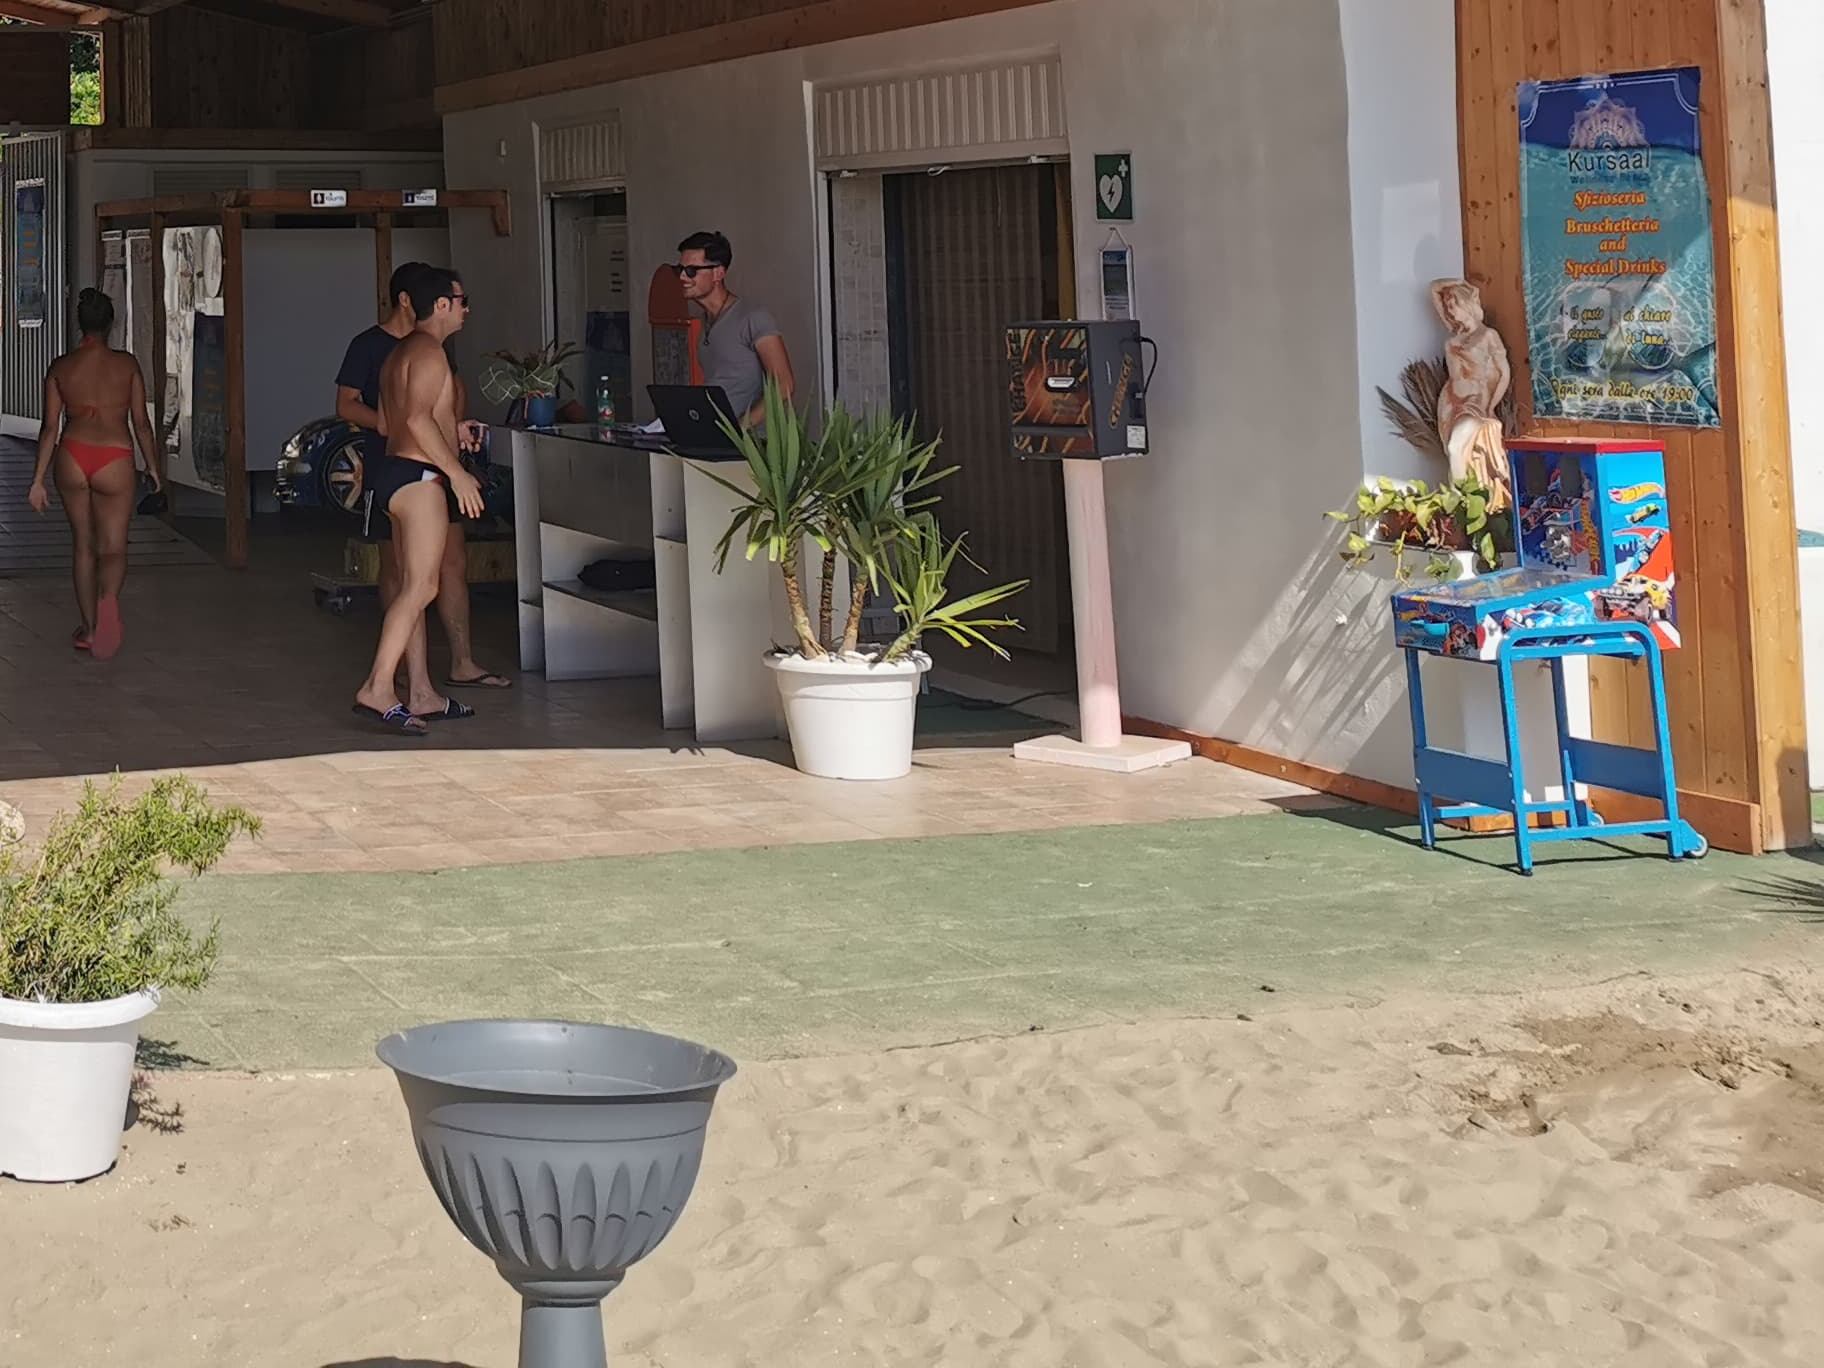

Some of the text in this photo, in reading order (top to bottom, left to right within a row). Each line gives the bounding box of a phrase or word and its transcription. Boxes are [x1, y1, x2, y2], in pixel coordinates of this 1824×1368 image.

[1568, 147, 1650, 172] Kursaal
[1574, 190, 1646, 211] Sfizioseria
[1565, 217, 1660, 235] Bruschetteria
[1598, 234, 1628, 252] and
[1565, 257, 1666, 278] Special Drinks
[1550, 376, 1577, 398] Ogni
[1582, 383, 1603, 398] sera
[1662, 386, 1694, 401] 19:00
